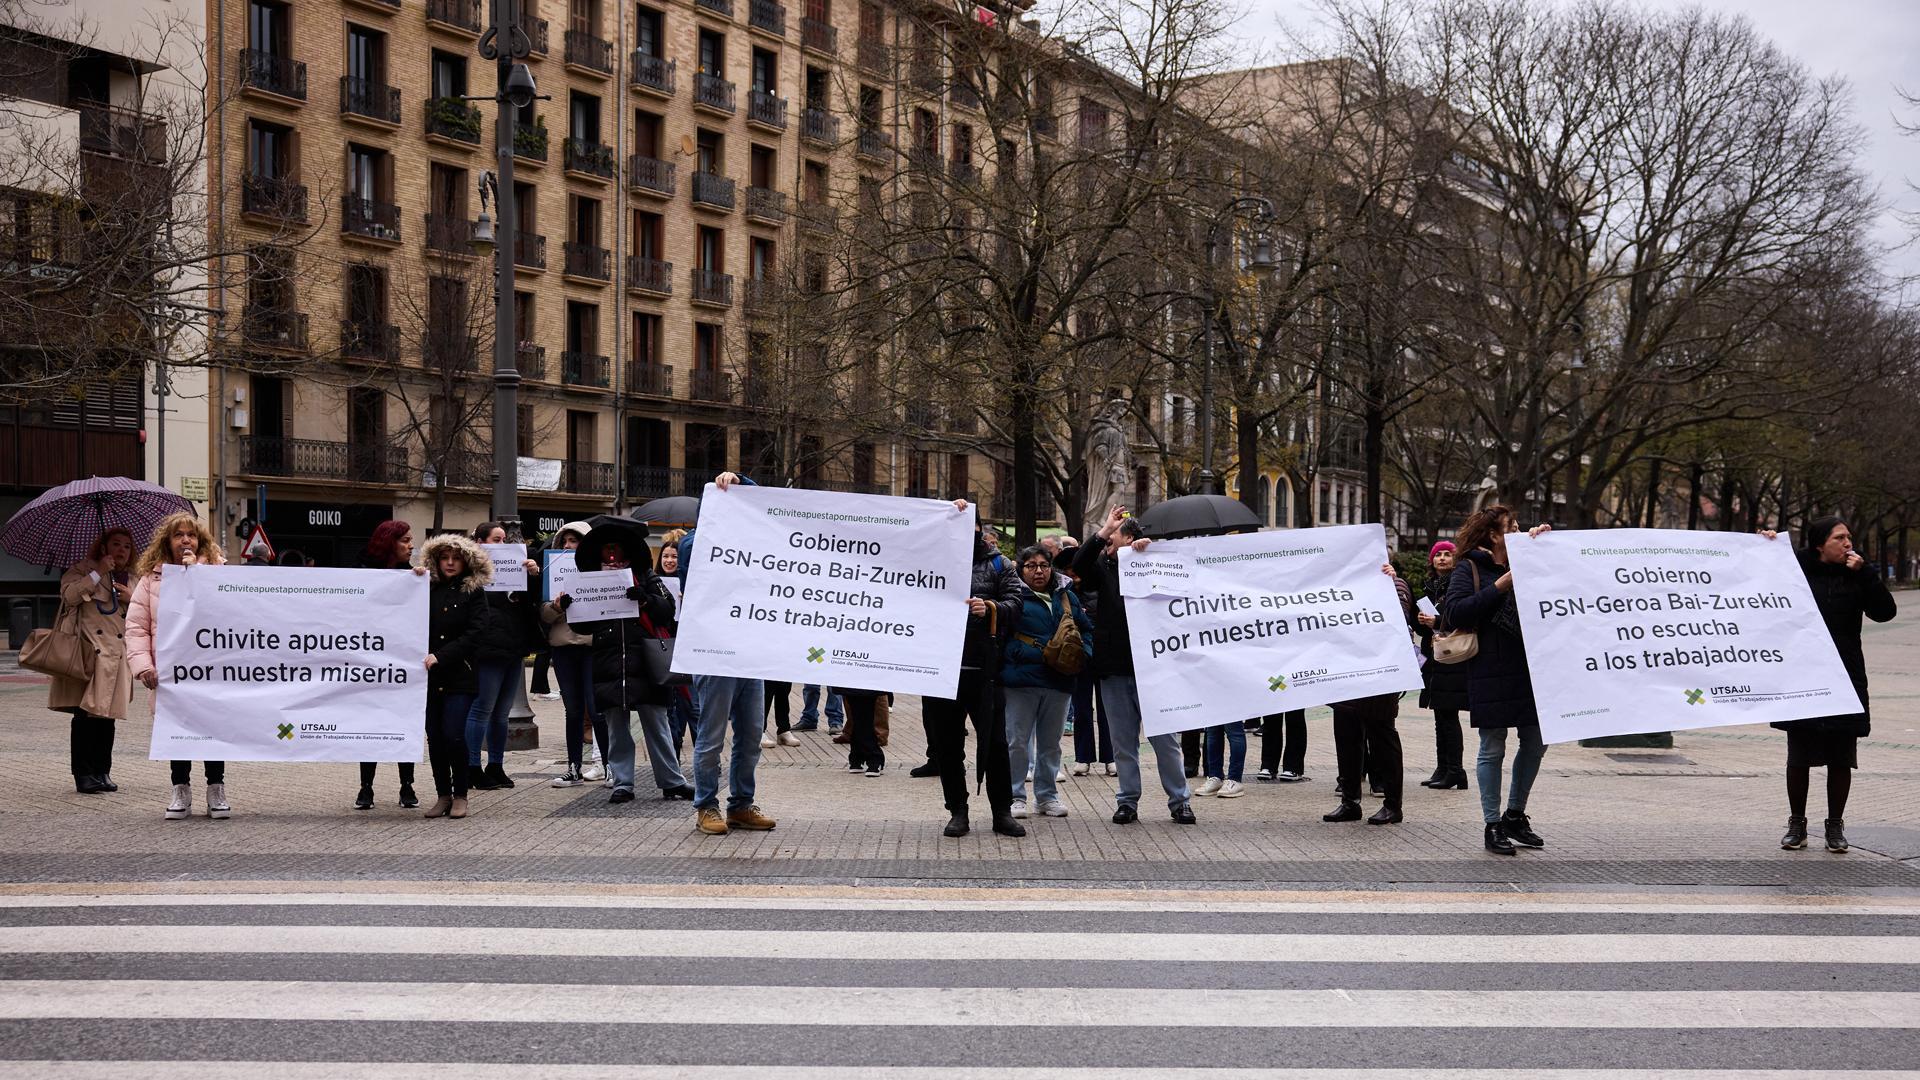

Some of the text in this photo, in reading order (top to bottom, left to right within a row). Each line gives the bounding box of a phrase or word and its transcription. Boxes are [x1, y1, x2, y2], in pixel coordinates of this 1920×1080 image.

[309, 510, 341, 525] GOIKO
[767, 507, 910, 526] #Chiviteapuestapornuestramiseria
[789, 532, 881, 556] Gobierno
[1581, 547, 1730, 558] #Chiviteapuestapornuestramiseria
[1196, 546, 1324, 564] iviteapuestapornuestramiseria
[710, 546, 946, 590] PSN-Geroa Bai-Zurekin
[1138, 569, 1162, 577] nuestra
[1155, 562, 1183, 570] apuesta
[1614, 567, 1712, 584] Gobierno
[218, 584, 365, 595] #Chiviteapuestapornuestramiseria
[769, 583, 884, 608] no escucha
[1168, 588, 1354, 618] Chivite apuesta
[1539, 592, 1792, 619] PSN-Geroa Bai-Zurekin
[730, 604, 915, 637] a los trabajadores
[1616, 619, 1740, 640] no escucha
[195, 628, 385, 654] Chivite apuesta
[1150, 608, 1384, 658] por nuestra miseria
[832, 649, 870, 660] UTSAJU
[1585, 645, 1784, 671] a los trabajadores
[173, 663, 407, 684] por nuestra miseria
[1292, 668, 1328, 680] UTSAJU
[1710, 685, 1751, 695] UTSAJU
